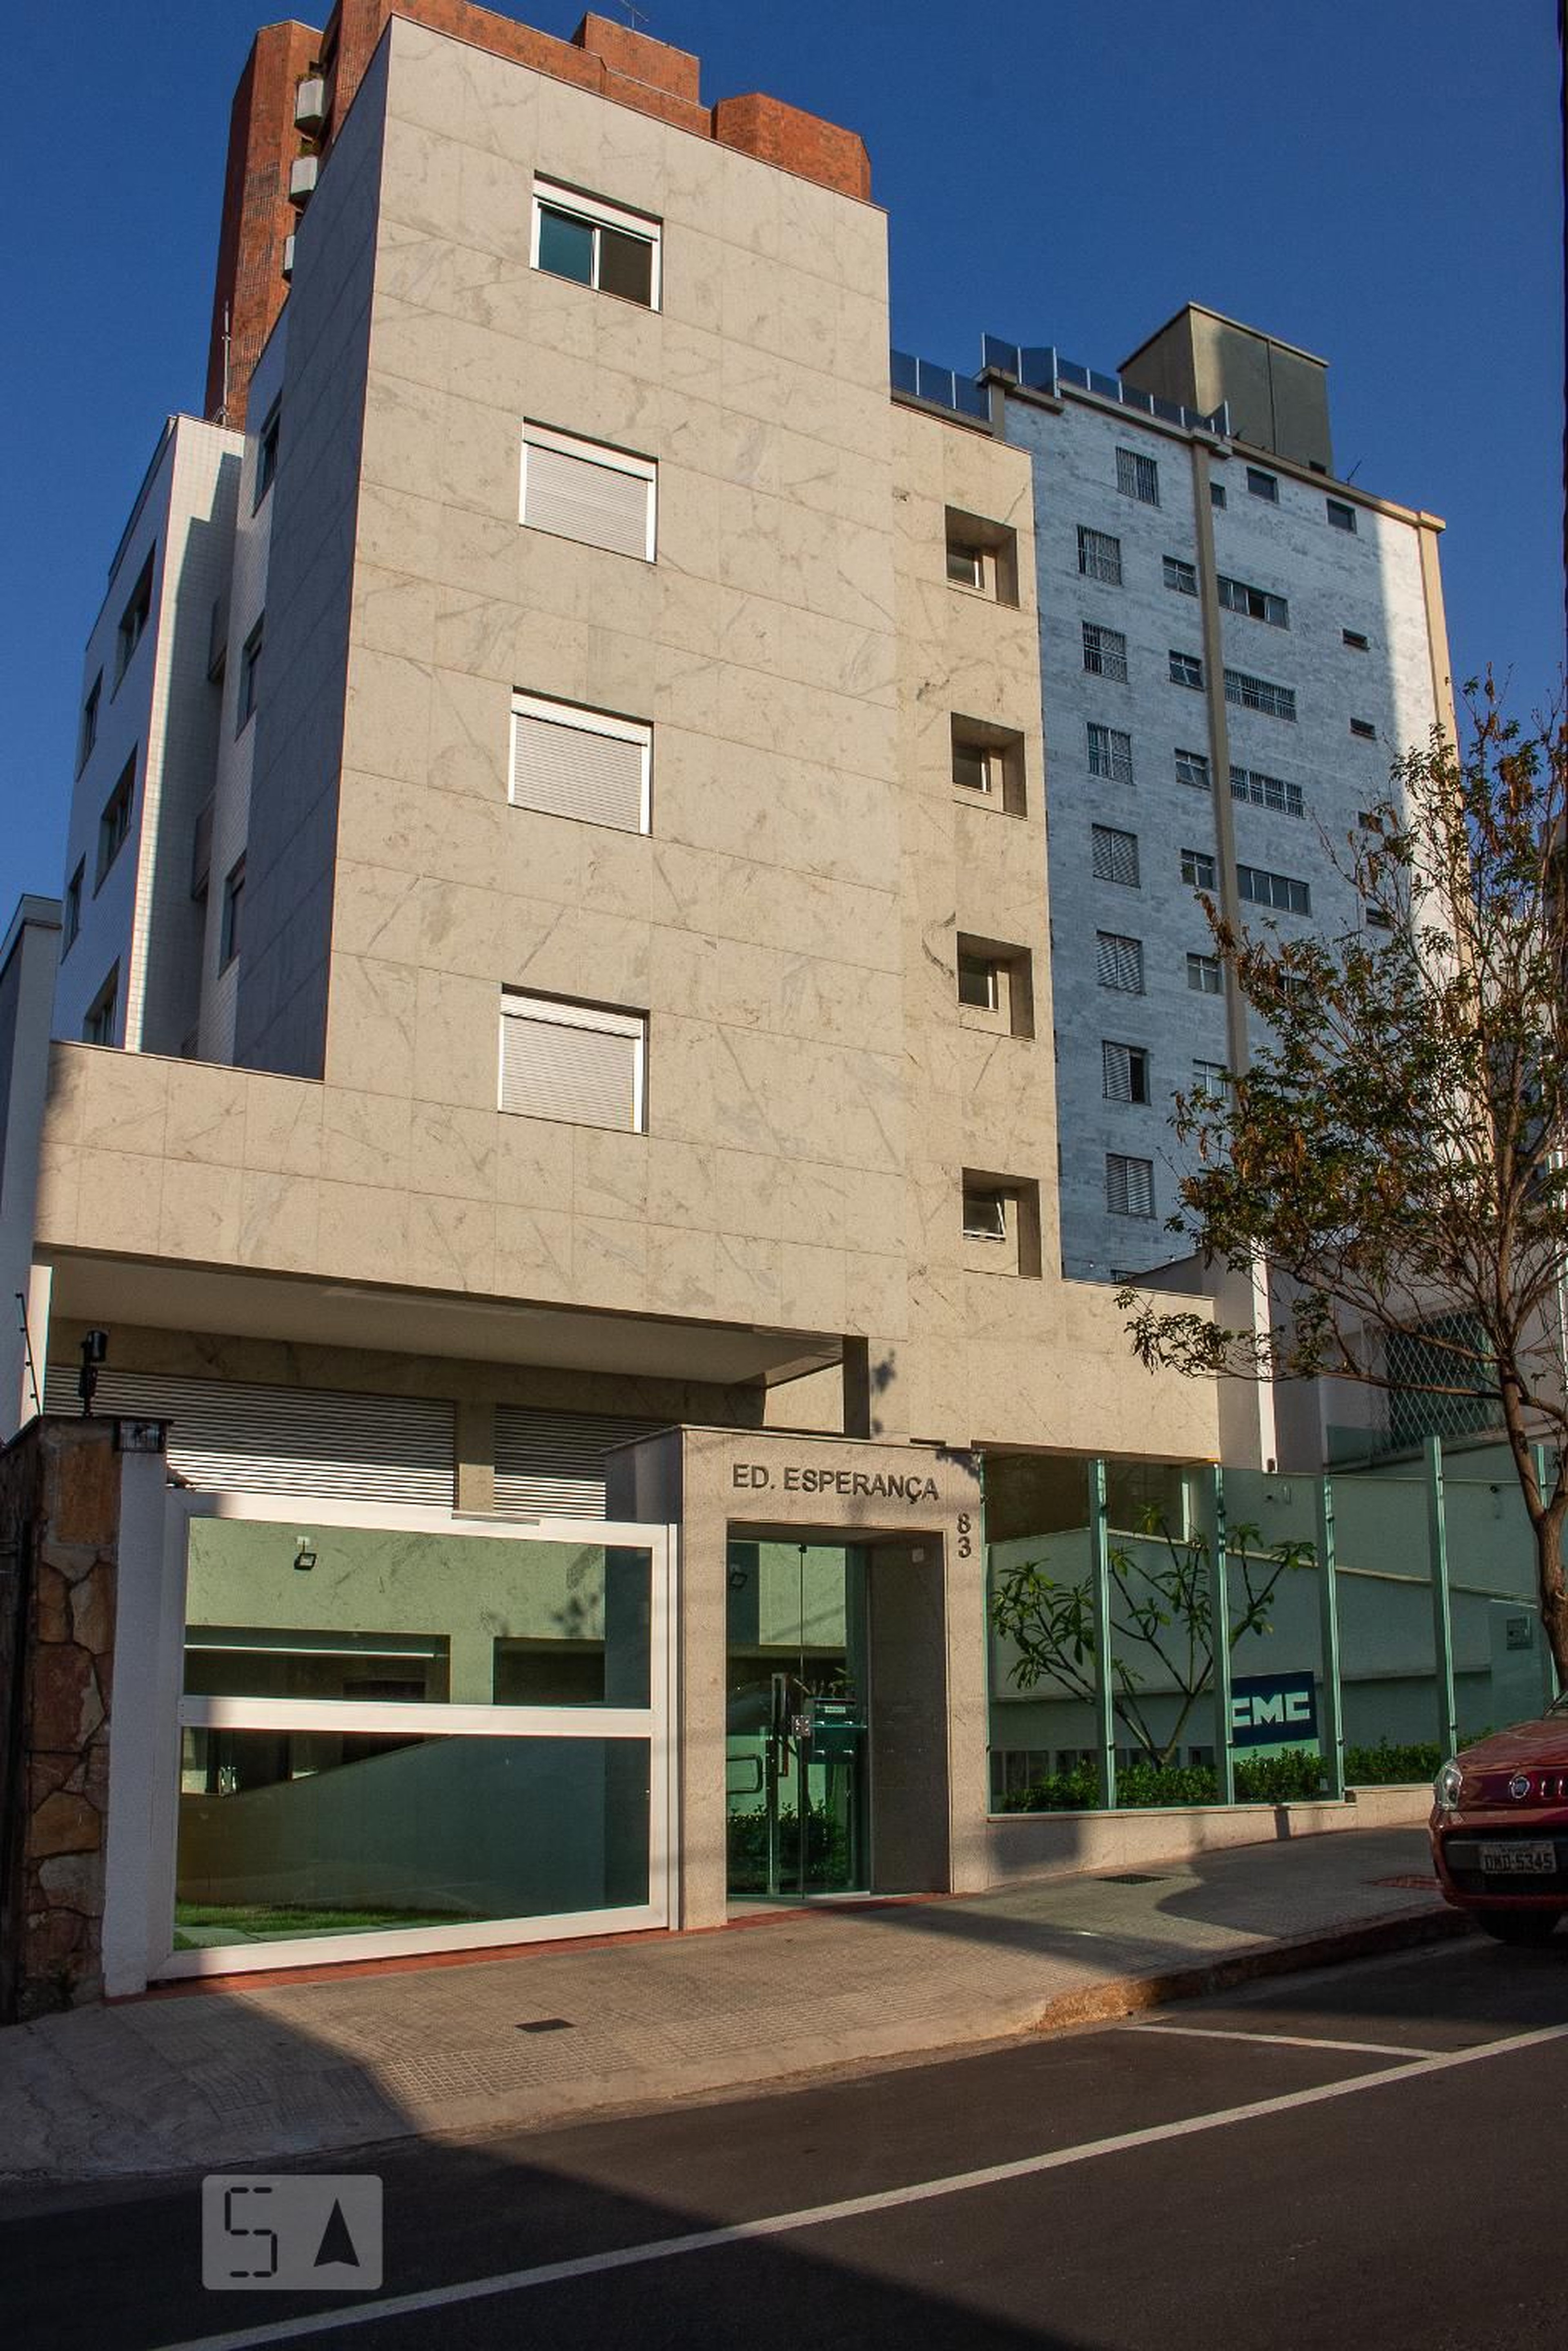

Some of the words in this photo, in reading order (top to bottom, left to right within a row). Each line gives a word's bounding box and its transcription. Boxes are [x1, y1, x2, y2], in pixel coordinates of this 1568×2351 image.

[733, 1464, 775, 1489] ED.
[784, 1467, 939, 1504] ESPERANÇA
[957, 1512, 971, 1558] 83
